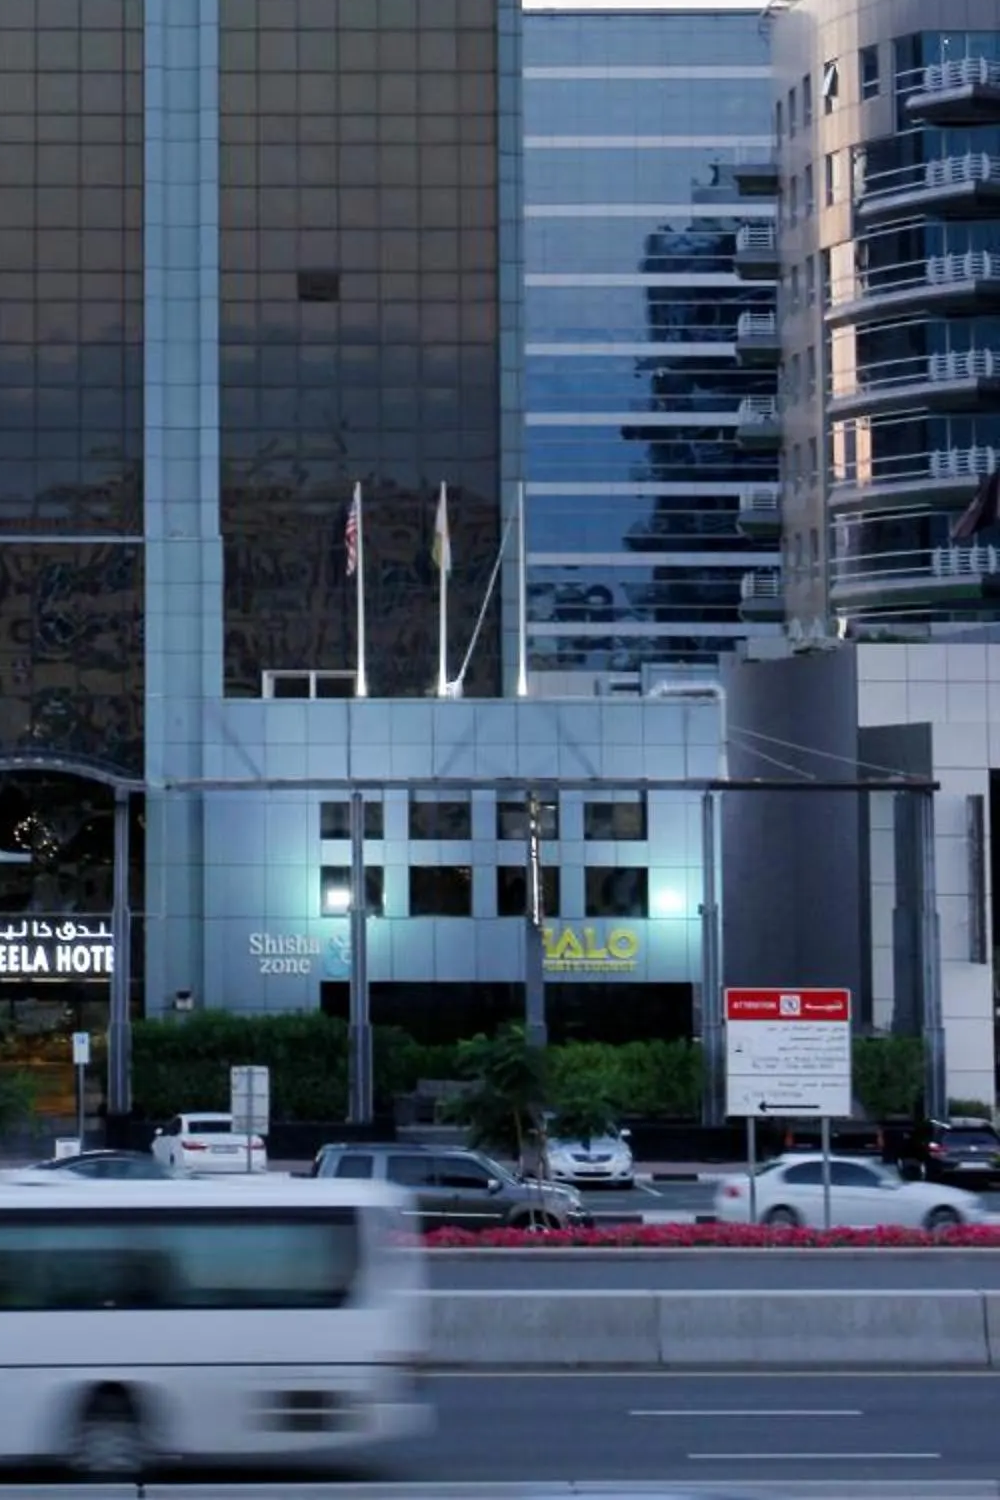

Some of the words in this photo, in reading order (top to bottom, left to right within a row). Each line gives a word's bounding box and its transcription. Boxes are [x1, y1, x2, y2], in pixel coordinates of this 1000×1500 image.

[249, 933, 320, 955] Shisha
[56, 945, 115, 973] HOTE
[260, 957, 311, 974] zone
